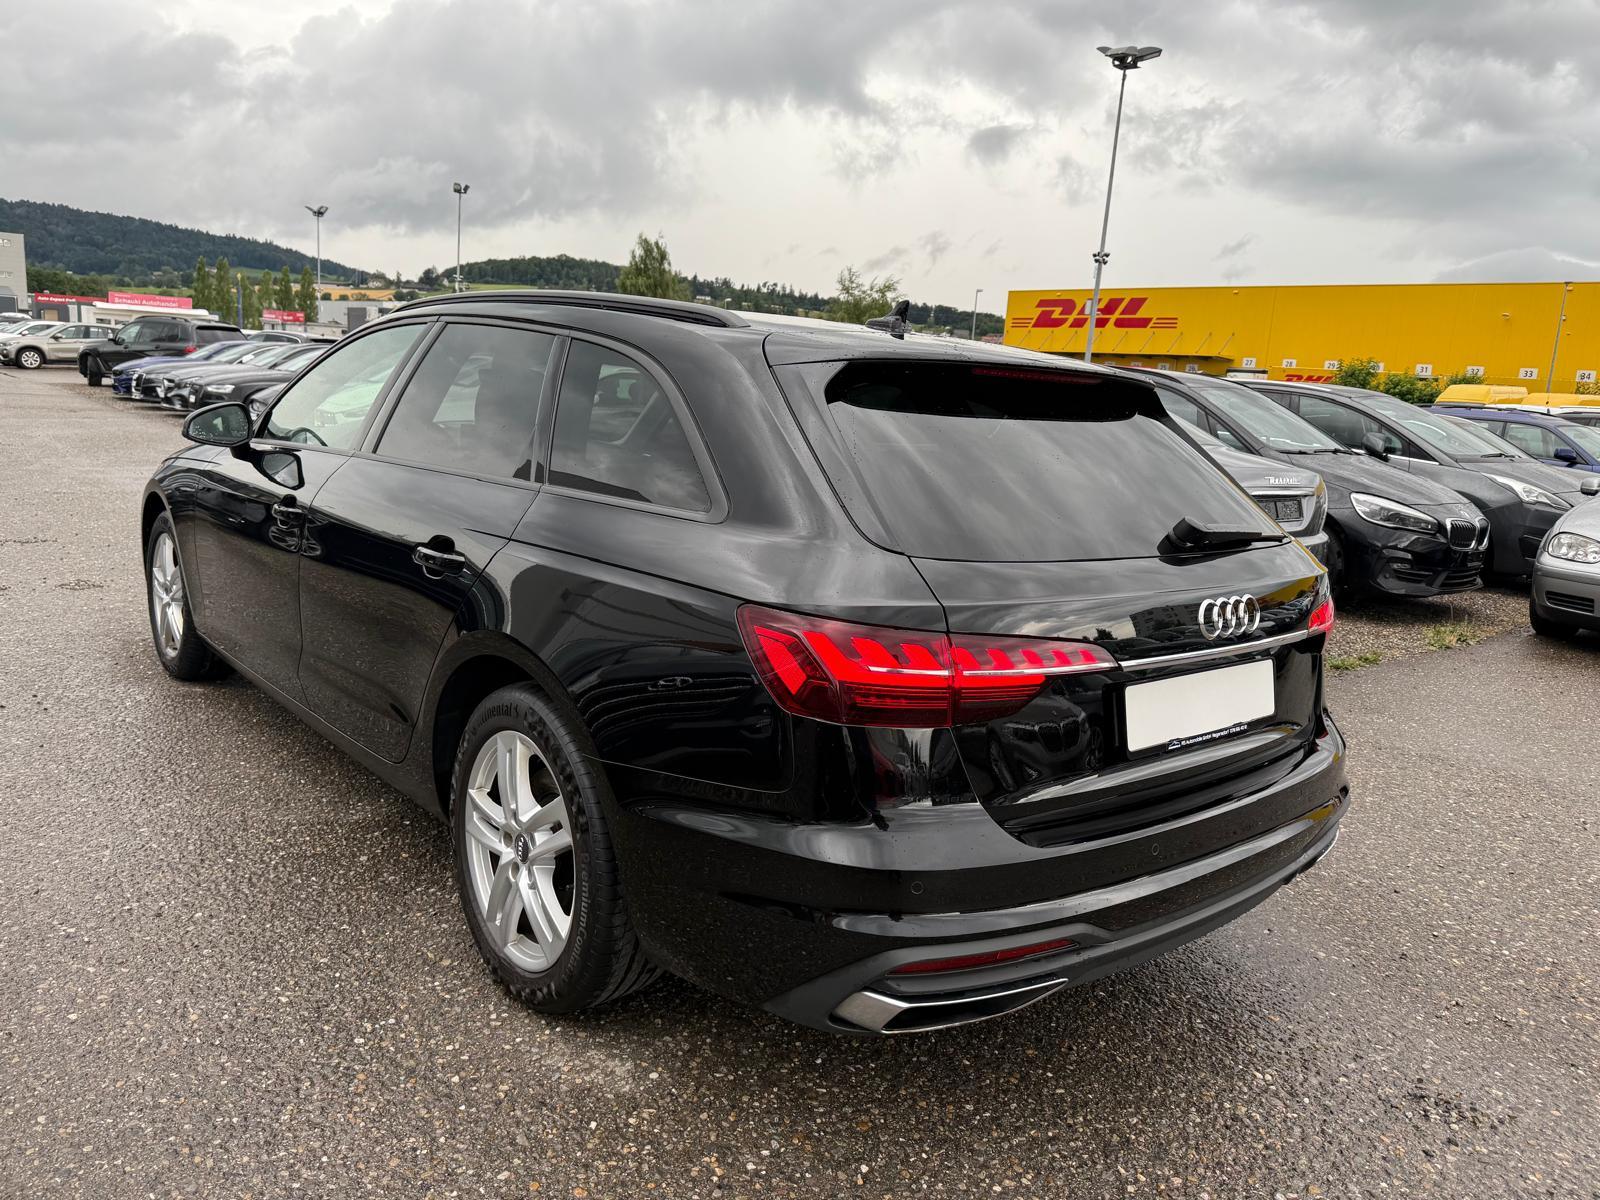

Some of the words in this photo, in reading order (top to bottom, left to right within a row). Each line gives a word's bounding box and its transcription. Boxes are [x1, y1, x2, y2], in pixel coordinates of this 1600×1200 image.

[142, 299, 179, 307] Autohandel
[1031, 297, 1154, 328] DHL
[1244, 359, 1253, 367] 27
[1285, 360, 1293, 368] 28
[1418, 366, 1428, 374] 31
[1470, 368, 1480, 376] 32
[1523, 370, 1534, 378] 33
